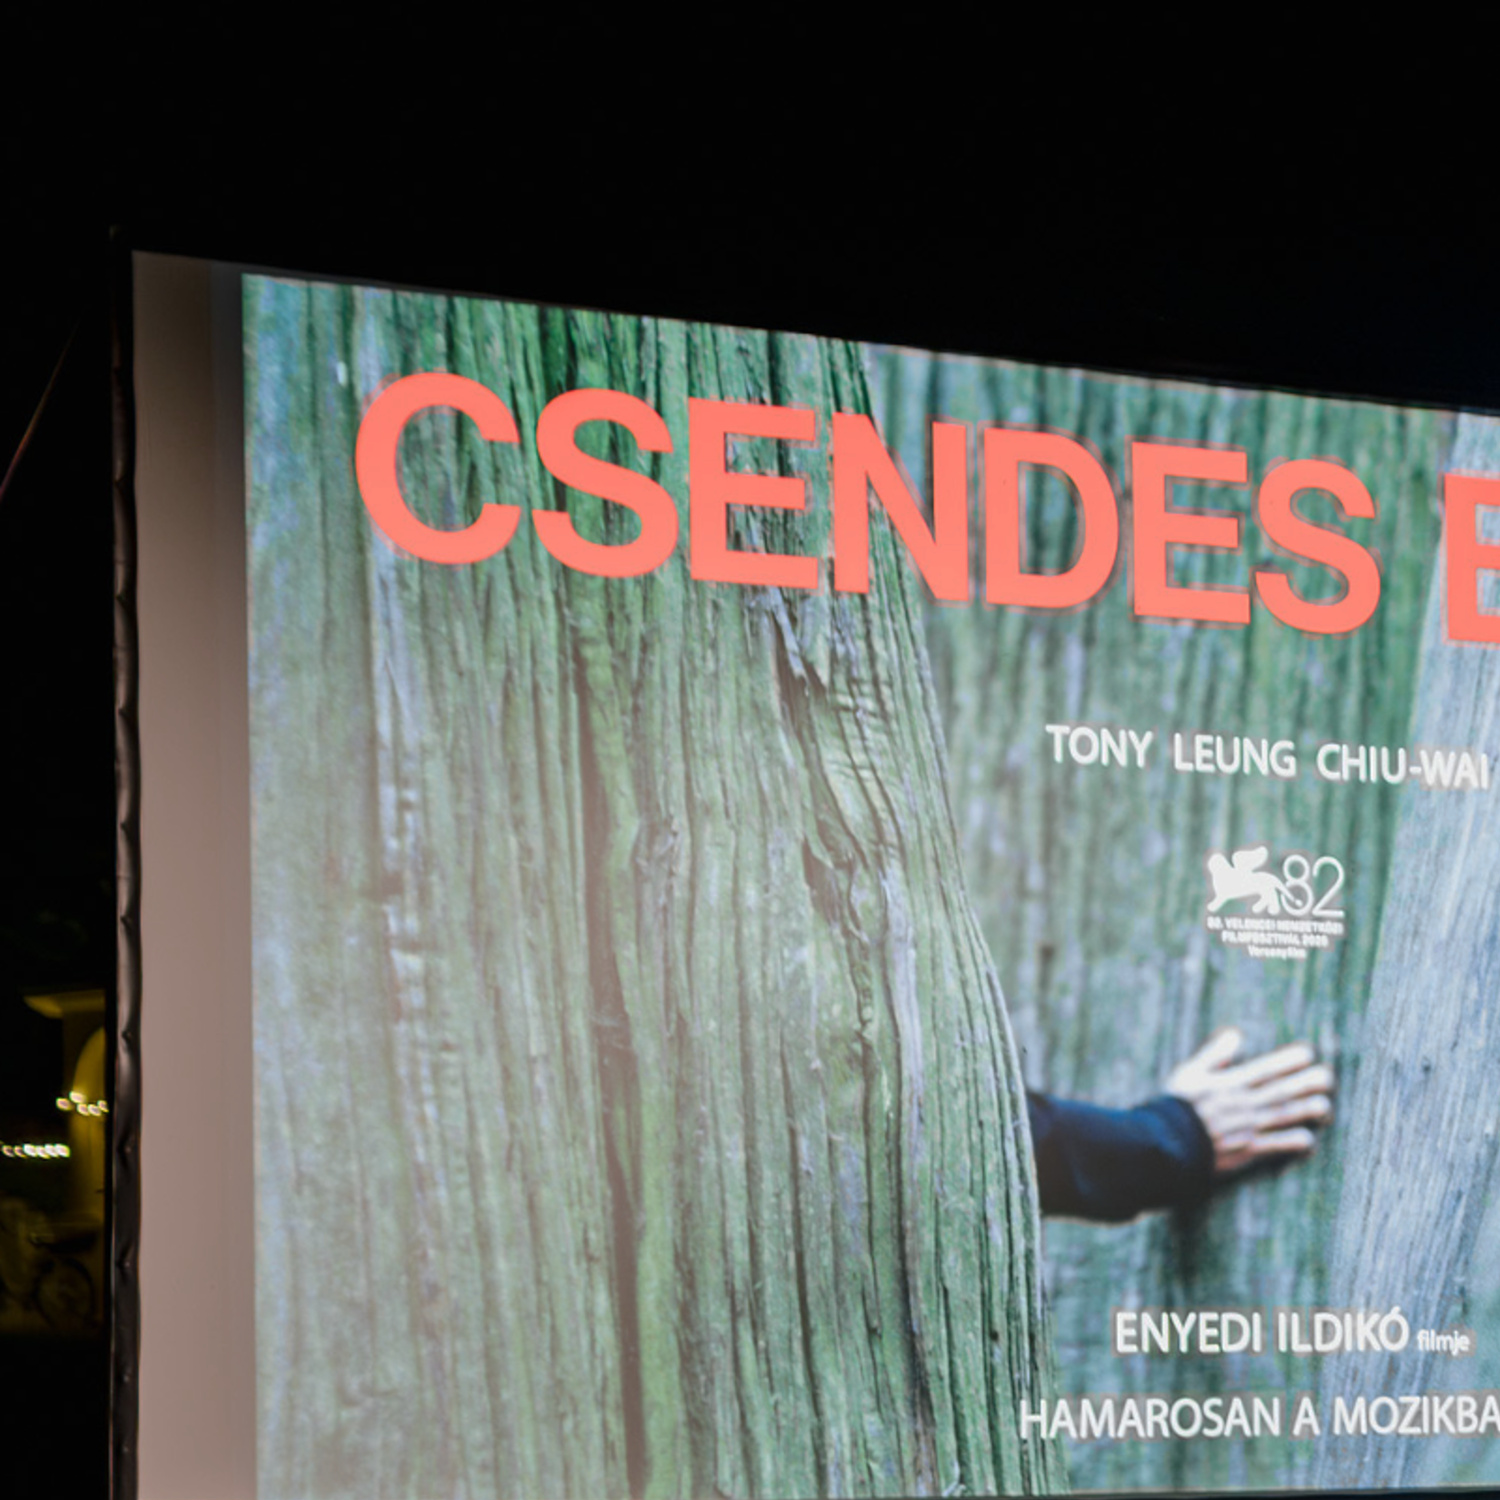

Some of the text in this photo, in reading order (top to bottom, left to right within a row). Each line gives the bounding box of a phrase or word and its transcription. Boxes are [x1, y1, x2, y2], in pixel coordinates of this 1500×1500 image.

[355, 371, 1382, 634] CSENDES
[1045, 724, 1490, 789] TONY LEUNG CHIU-WAI
[1280, 854, 1345, 916] 82
[1115, 1306, 1471, 1356] ENYEDI ILDIKÓ filmje
[1020, 1397, 1281, 1439] HAMAROSAN
[1292, 1397, 1321, 1437] A
